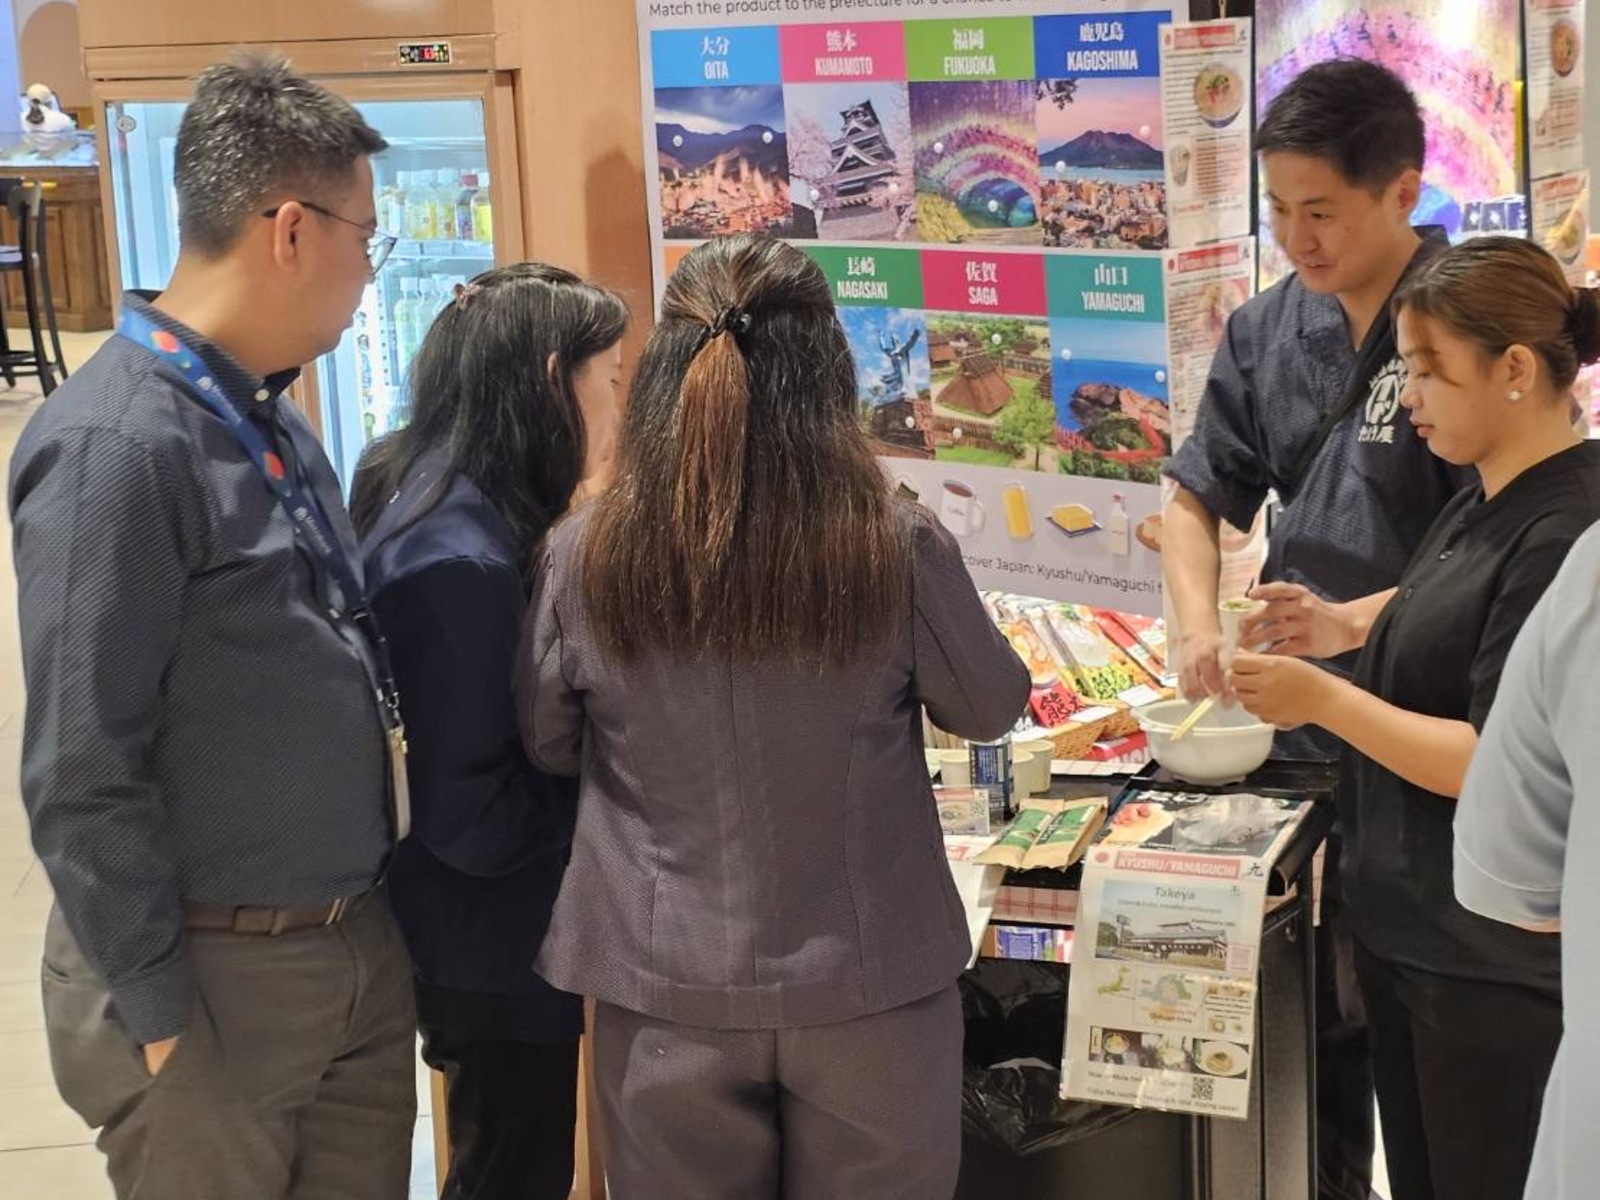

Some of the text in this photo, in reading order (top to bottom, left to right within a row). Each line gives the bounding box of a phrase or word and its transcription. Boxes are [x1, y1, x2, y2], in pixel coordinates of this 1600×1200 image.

[649, 2, 693, 16] Match
[697, 1, 722, 14] the
[726, 0, 781, 15] product
[786, 0, 800, 10] to
[803, 0, 826, 9] the
[701, 35, 730, 56] 大分
[826, 30, 858, 52] 熊本
[953, 28, 985, 50] 福岡
[704, 60, 729, 80] OITA
[815, 57, 873, 76] KUMAMOTO
[944, 55, 996, 76] FUKUOKA
[1067, 50, 1138, 72] KAGOSHIMA
[847, 256, 875, 277] 長崎
[965, 261, 999, 283] 佐賀
[1094, 263, 1128, 286] 山口
[837, 280, 888, 299] NAGASAKI
[968, 286, 998, 306] SAGA
[1082, 291, 1145, 313] YAMAGUCHI
[962, 554, 992, 569] cover
[996, 557, 1034, 574] Japan:
[1037, 563, 1155, 594] Kyushu/Yamaguchi
[1117, 857, 1237, 876] KYUSHU/YAMAGUCHI
[1154, 886, 1196, 901] Takeya
